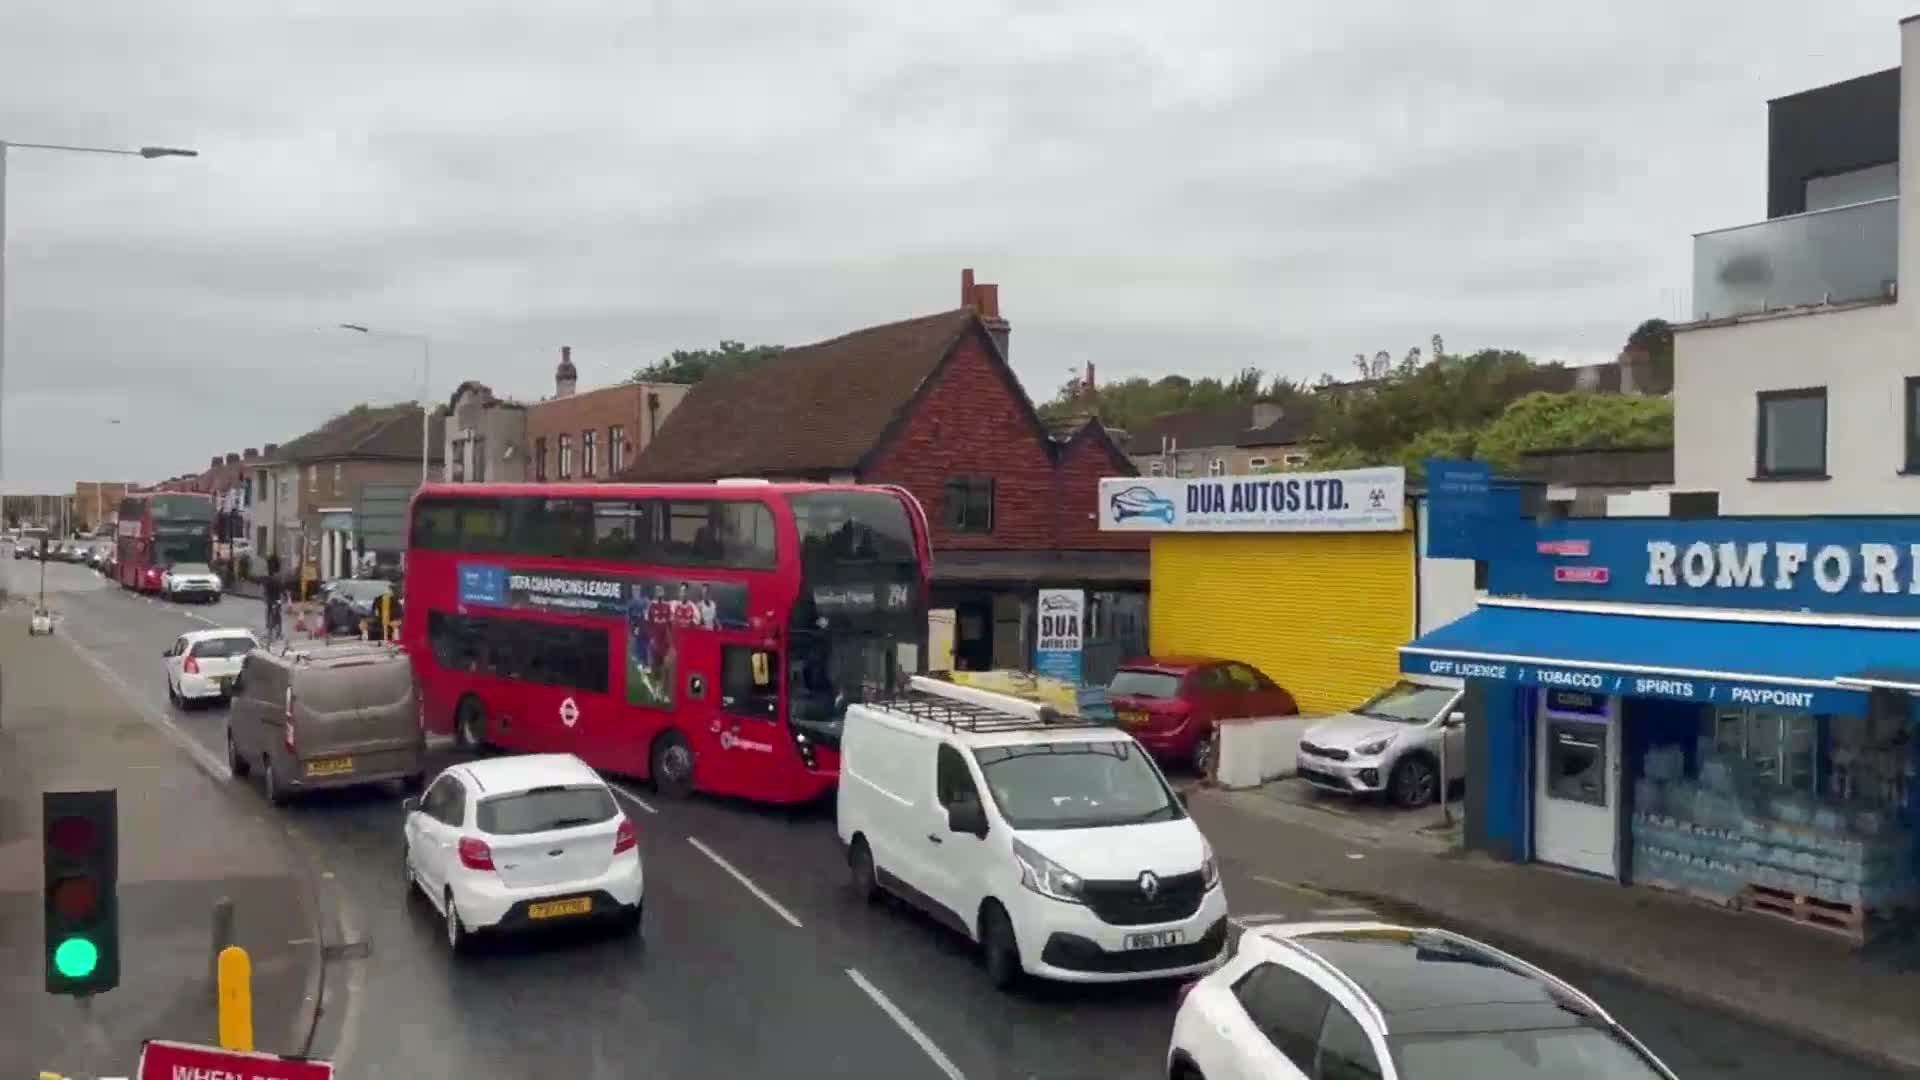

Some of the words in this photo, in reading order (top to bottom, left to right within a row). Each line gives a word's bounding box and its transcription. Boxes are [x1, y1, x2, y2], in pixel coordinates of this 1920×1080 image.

[1186, 483, 1225, 514] DUA
[1230, 479, 1300, 513] AUTOS
[1304, 478, 1349, 512] LTD.
[1645, 541, 1920, 595] ROMFOR
[529, 577, 583, 595] CHAMPIONS
[584, 580, 621, 598] LEAGUE
[1041, 615, 1079, 637] DUA
[1429, 660, 1453, 674] OFF
[1455, 662, 1507, 679] LICENCE
[1536, 669, 1603, 688] TOBACCO
[1635, 679, 1694, 697] SPIRITS
[1731, 686, 1814, 708] PAYPOINT
